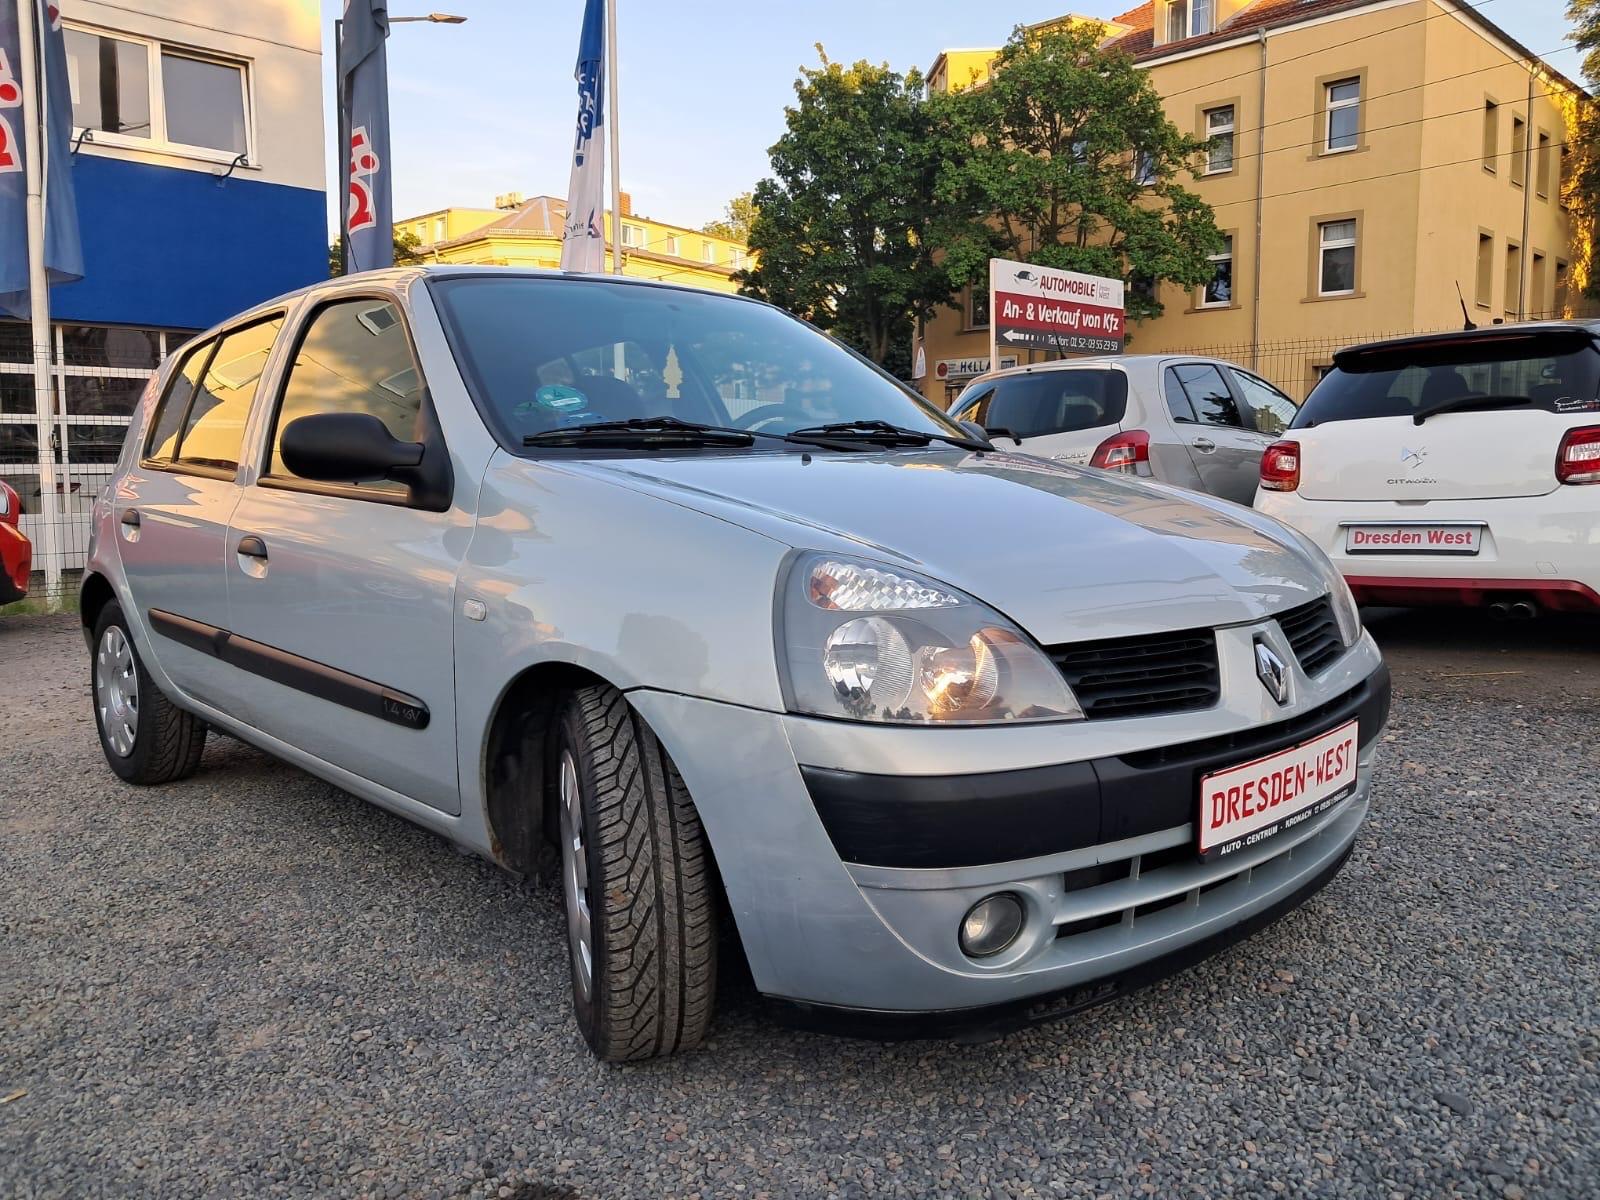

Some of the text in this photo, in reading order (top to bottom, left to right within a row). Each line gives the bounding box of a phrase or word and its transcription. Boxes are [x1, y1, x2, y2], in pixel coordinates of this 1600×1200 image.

[1040, 275, 1096, 297] AUTOMOBILE
[1002, 299, 1119, 333] An- & Verkauf von Kfz
[1047, 334, 1068, 347] Telfon:
[1354, 529, 1472, 544] Dresden West
[1211, 739, 1352, 829] DRESDEN-WEST
[1220, 841, 1241, 856] AUTO
[1246, 824, 1278, 845] CENTRUM
[1285, 808, 1312, 827] KRONACH
